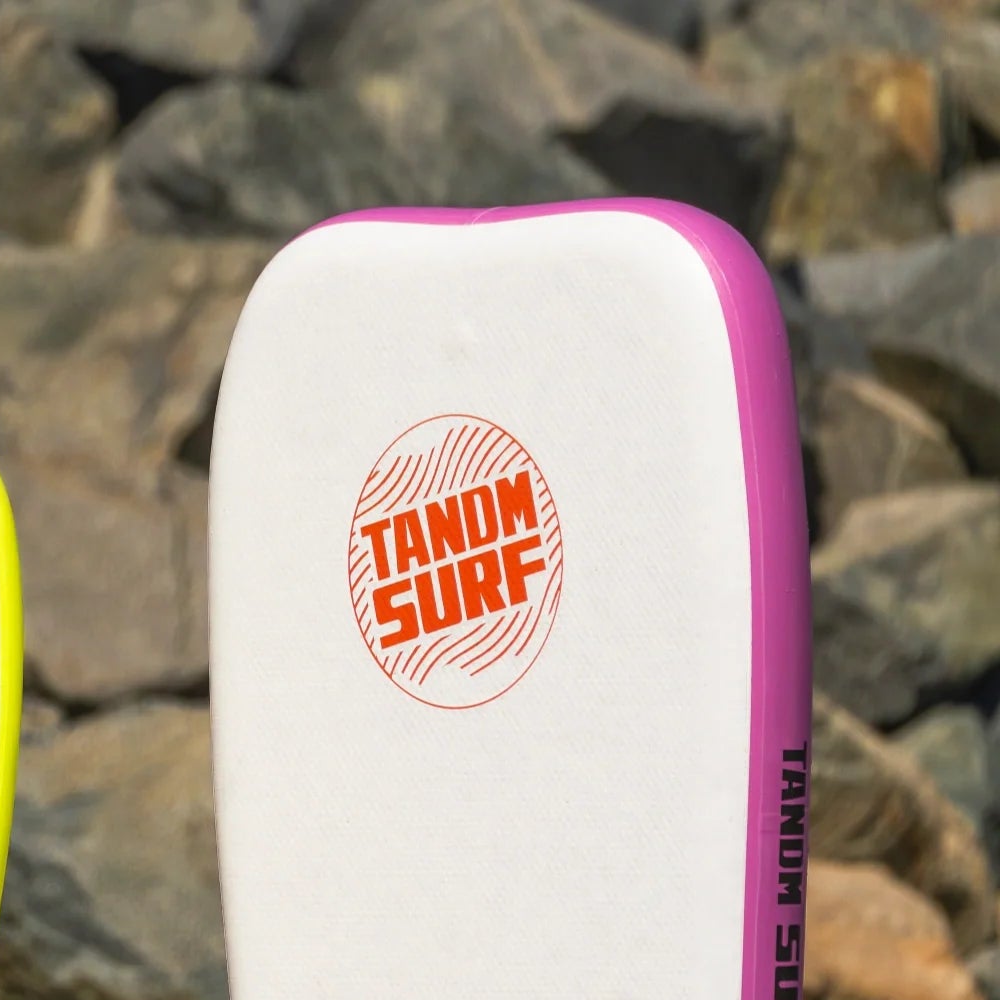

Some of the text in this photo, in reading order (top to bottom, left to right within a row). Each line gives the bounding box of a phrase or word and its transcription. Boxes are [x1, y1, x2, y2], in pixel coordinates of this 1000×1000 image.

[360, 469, 539, 581] TANDM
[372, 533, 547, 650] SURF
[777, 740, 808, 905] TANDM
